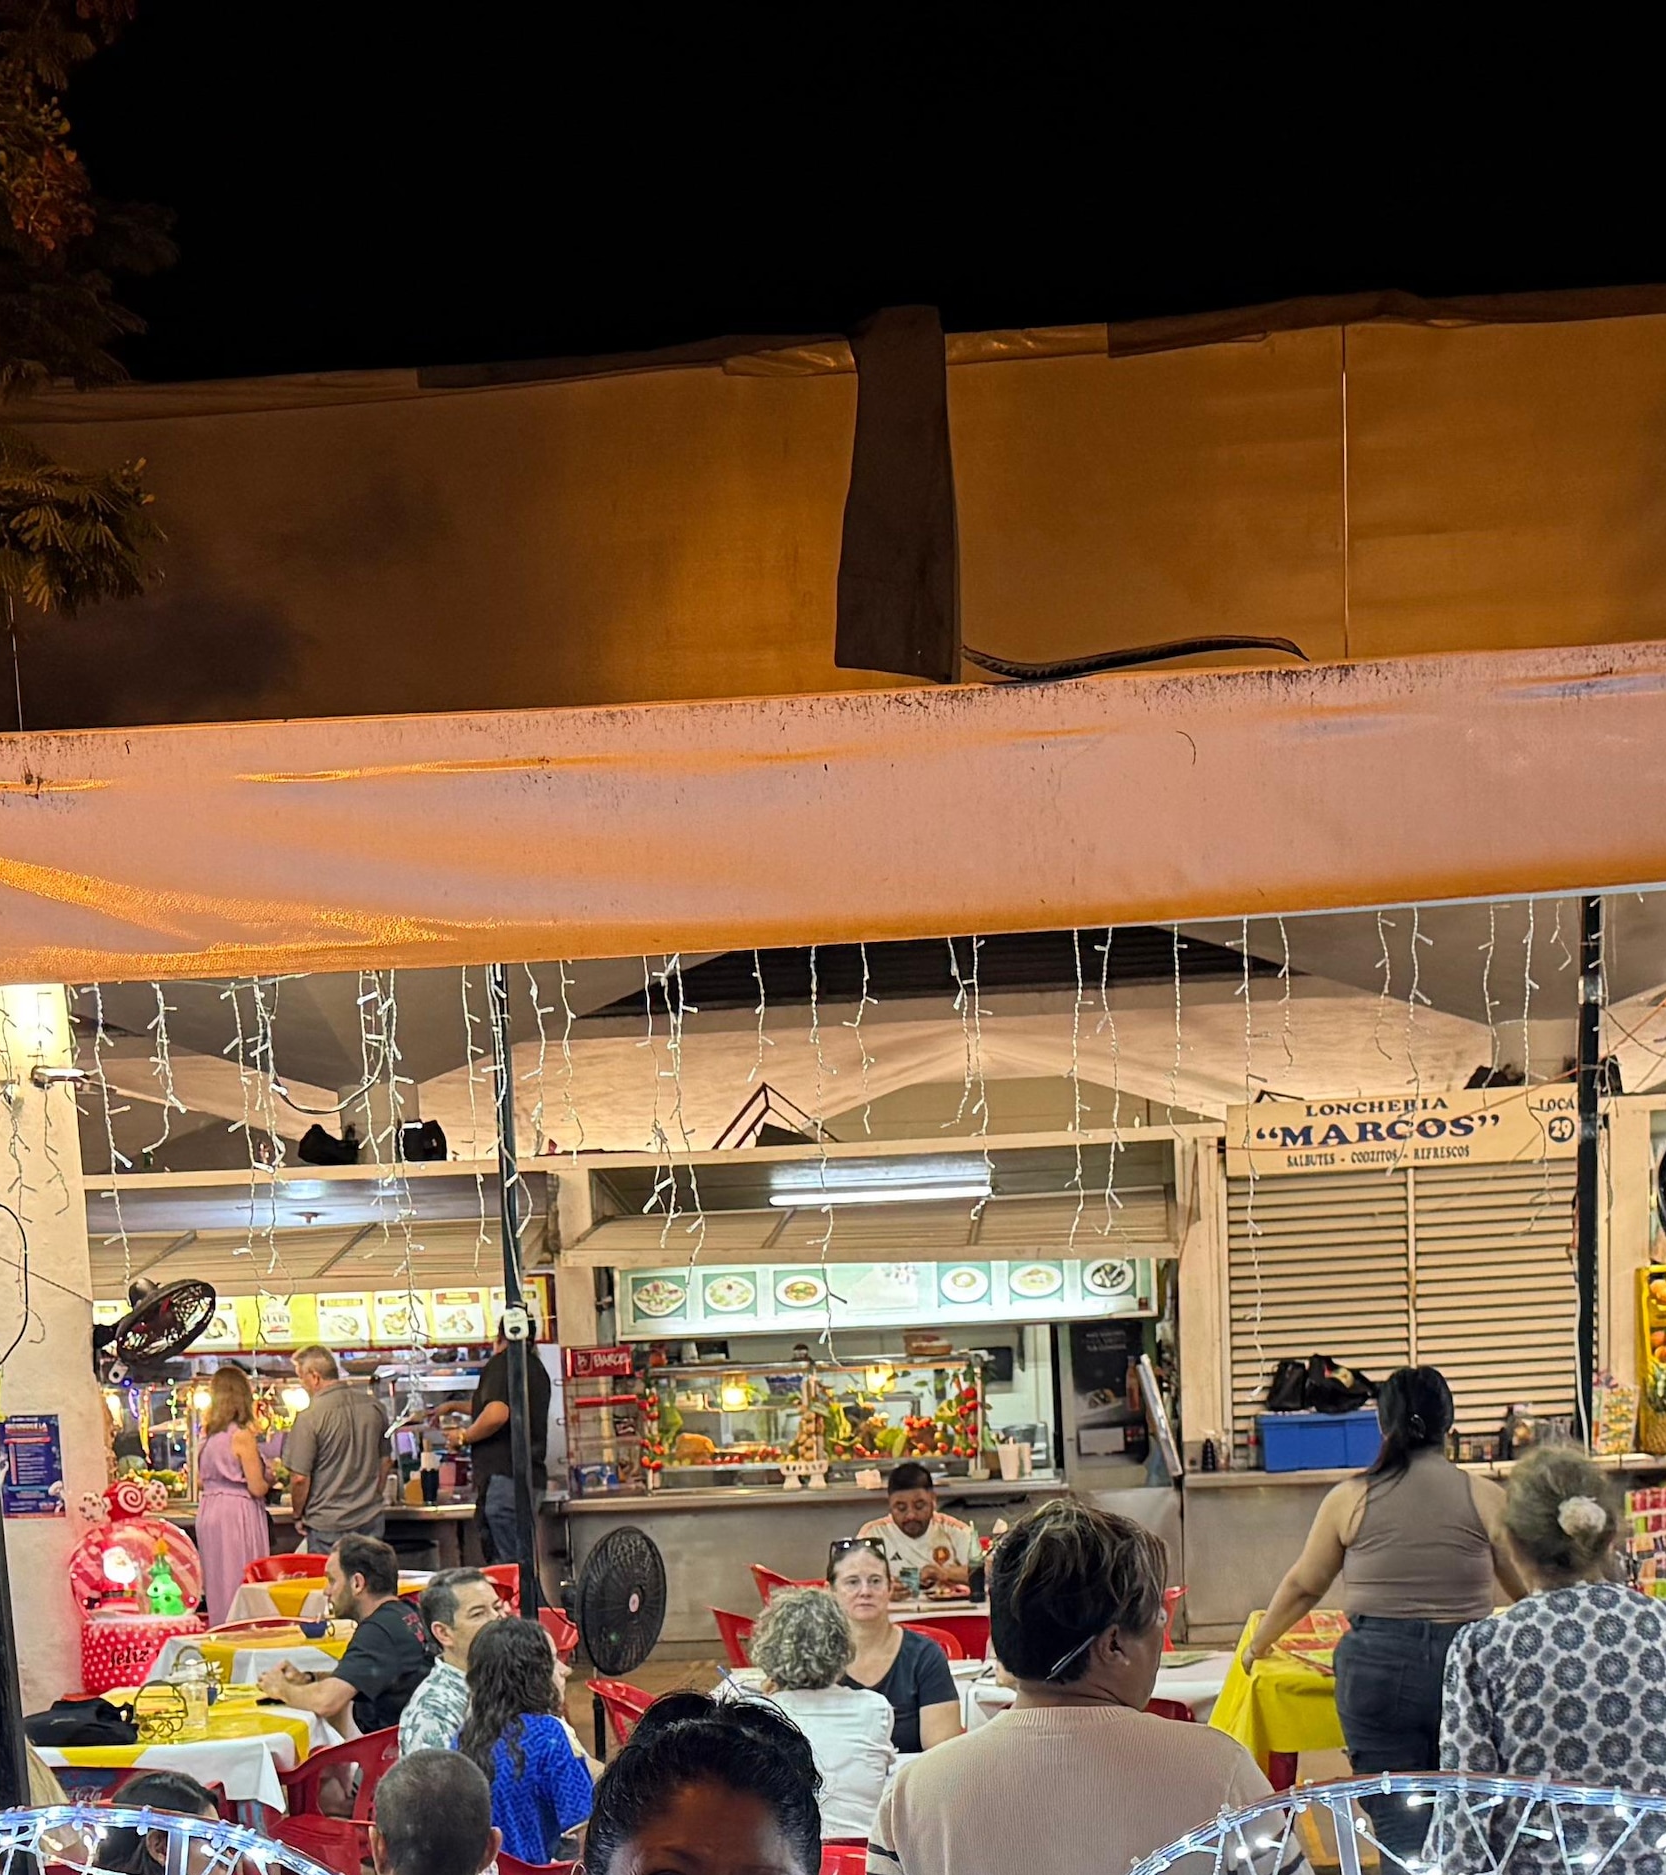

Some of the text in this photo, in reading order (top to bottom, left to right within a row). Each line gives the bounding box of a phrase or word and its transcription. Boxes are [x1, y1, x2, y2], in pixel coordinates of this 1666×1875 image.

[1305, 1097, 1449, 1118] LONCHERIA
[1539, 1097, 1575, 1111] LOCA
[1549, 1117, 1574, 1141] 29
